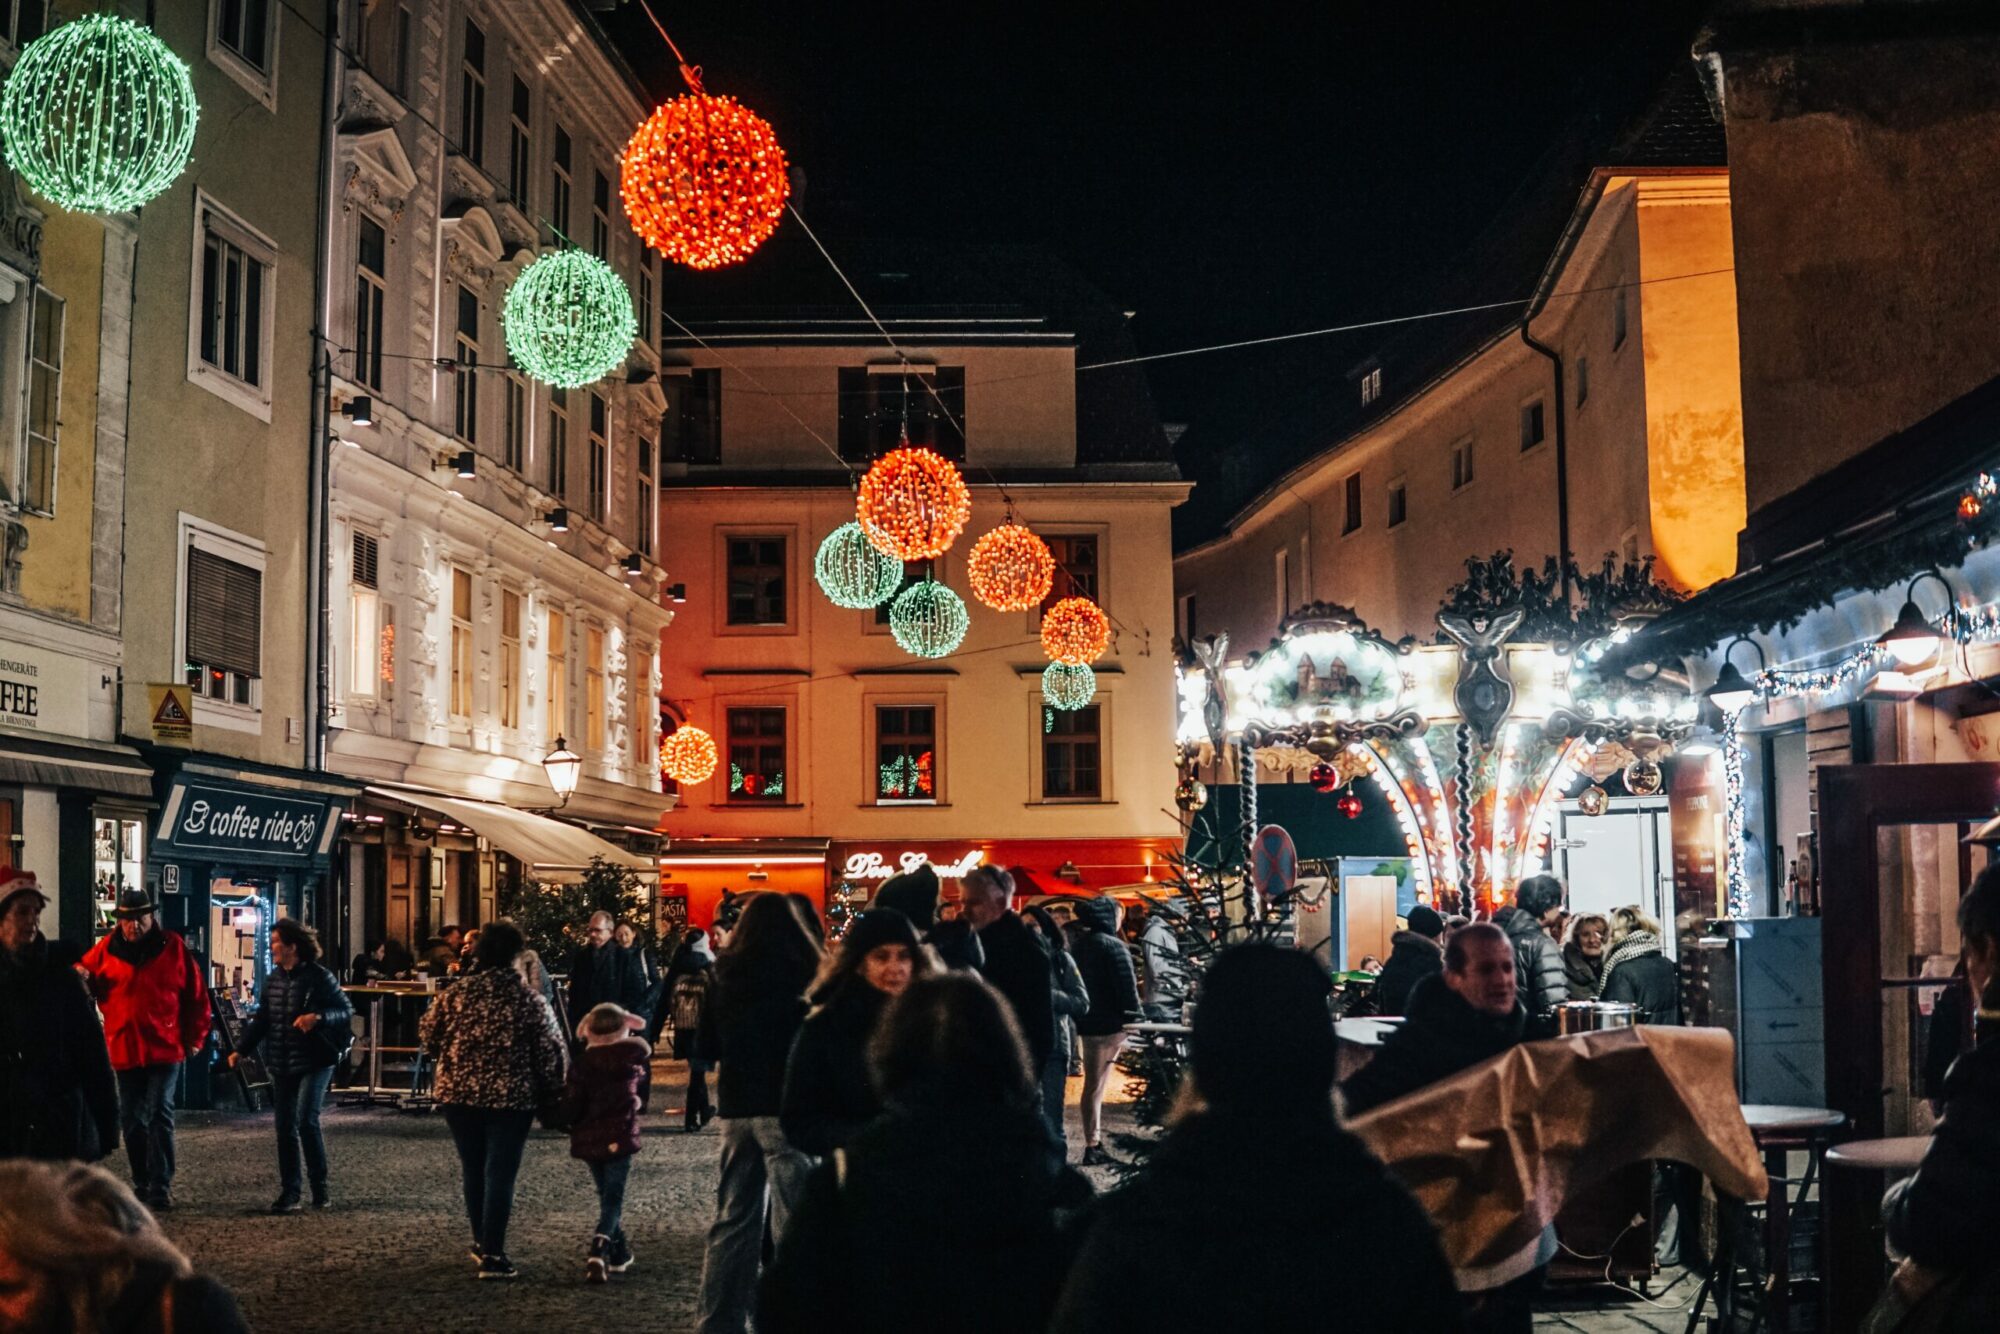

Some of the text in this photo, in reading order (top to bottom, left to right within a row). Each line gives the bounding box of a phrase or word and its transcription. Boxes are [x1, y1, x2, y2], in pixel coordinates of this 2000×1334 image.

[209, 805, 293, 842] coffee ride
[167, 867, 176, 884] 12
[843, 852, 895, 879] Don
[661, 904, 686, 917] PASTA
